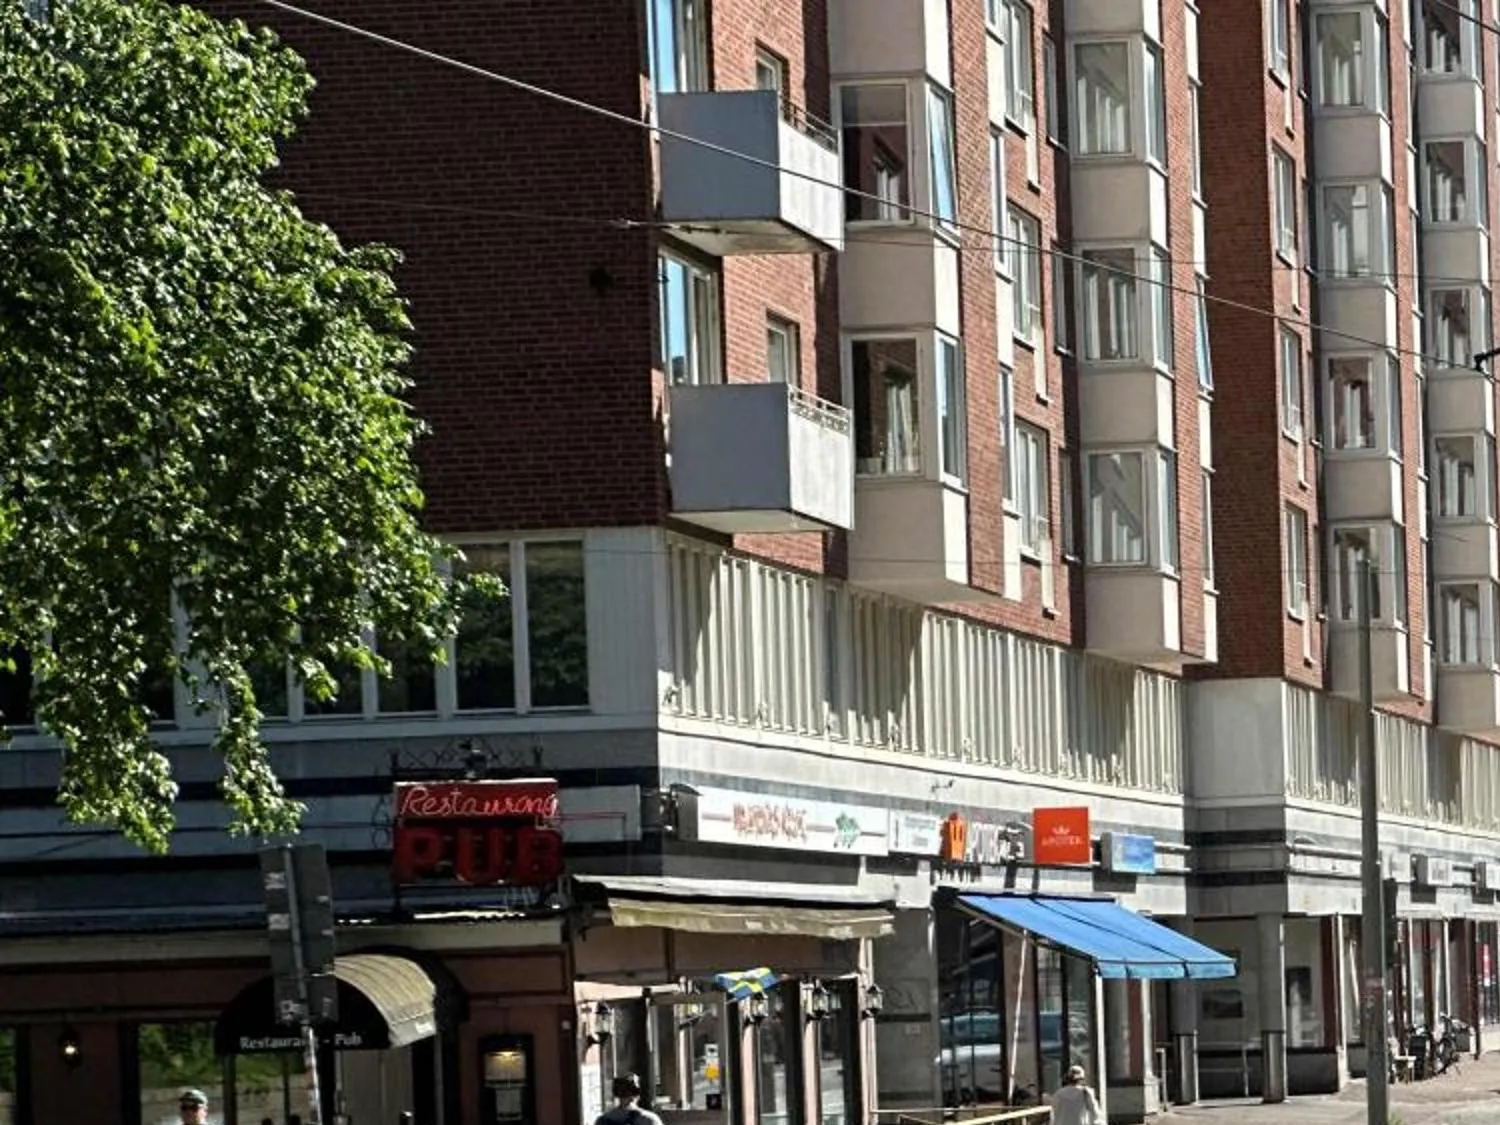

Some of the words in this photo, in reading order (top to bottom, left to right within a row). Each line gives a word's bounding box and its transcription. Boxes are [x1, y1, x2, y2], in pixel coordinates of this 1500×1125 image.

[400, 785, 557, 818] Restaurang
[394, 825, 563, 886] PUB
[239, 1036, 318, 1049] Restaura
